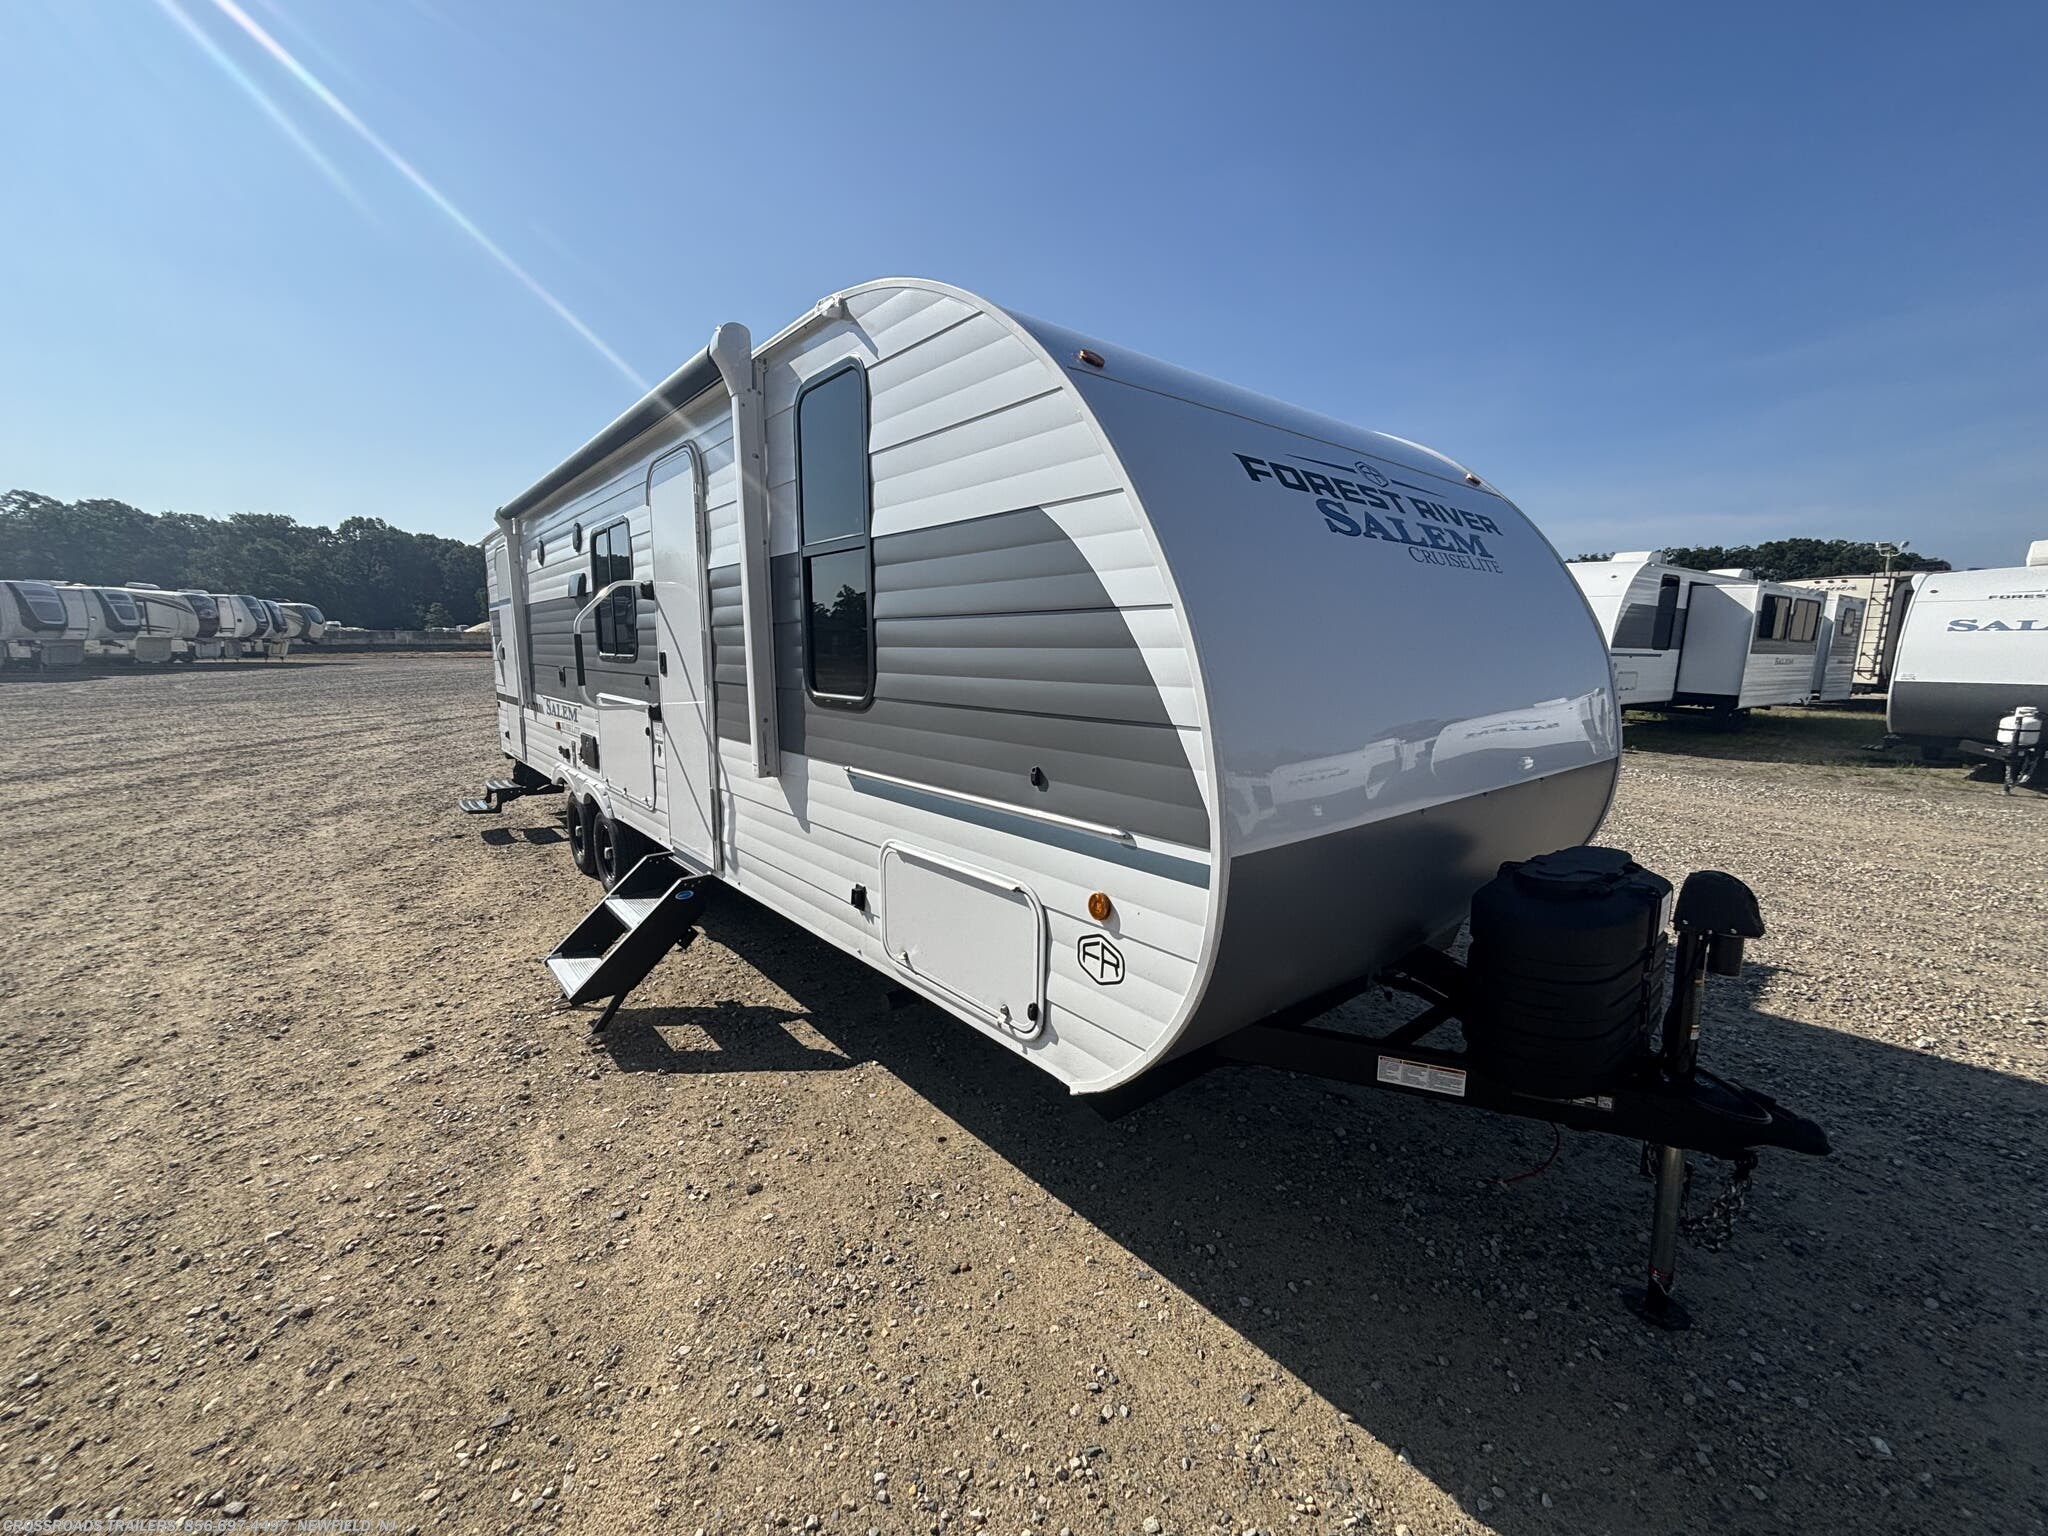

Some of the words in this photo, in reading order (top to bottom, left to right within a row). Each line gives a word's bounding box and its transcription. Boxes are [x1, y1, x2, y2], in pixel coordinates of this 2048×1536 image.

[1232, 452, 1407, 514] FOREST
[1406, 496, 1504, 536] RIVER
[1315, 498, 1494, 559] SALEM
[1408, 546, 1503, 574] CRUISELITE
[545, 698, 579, 723] SALEM
